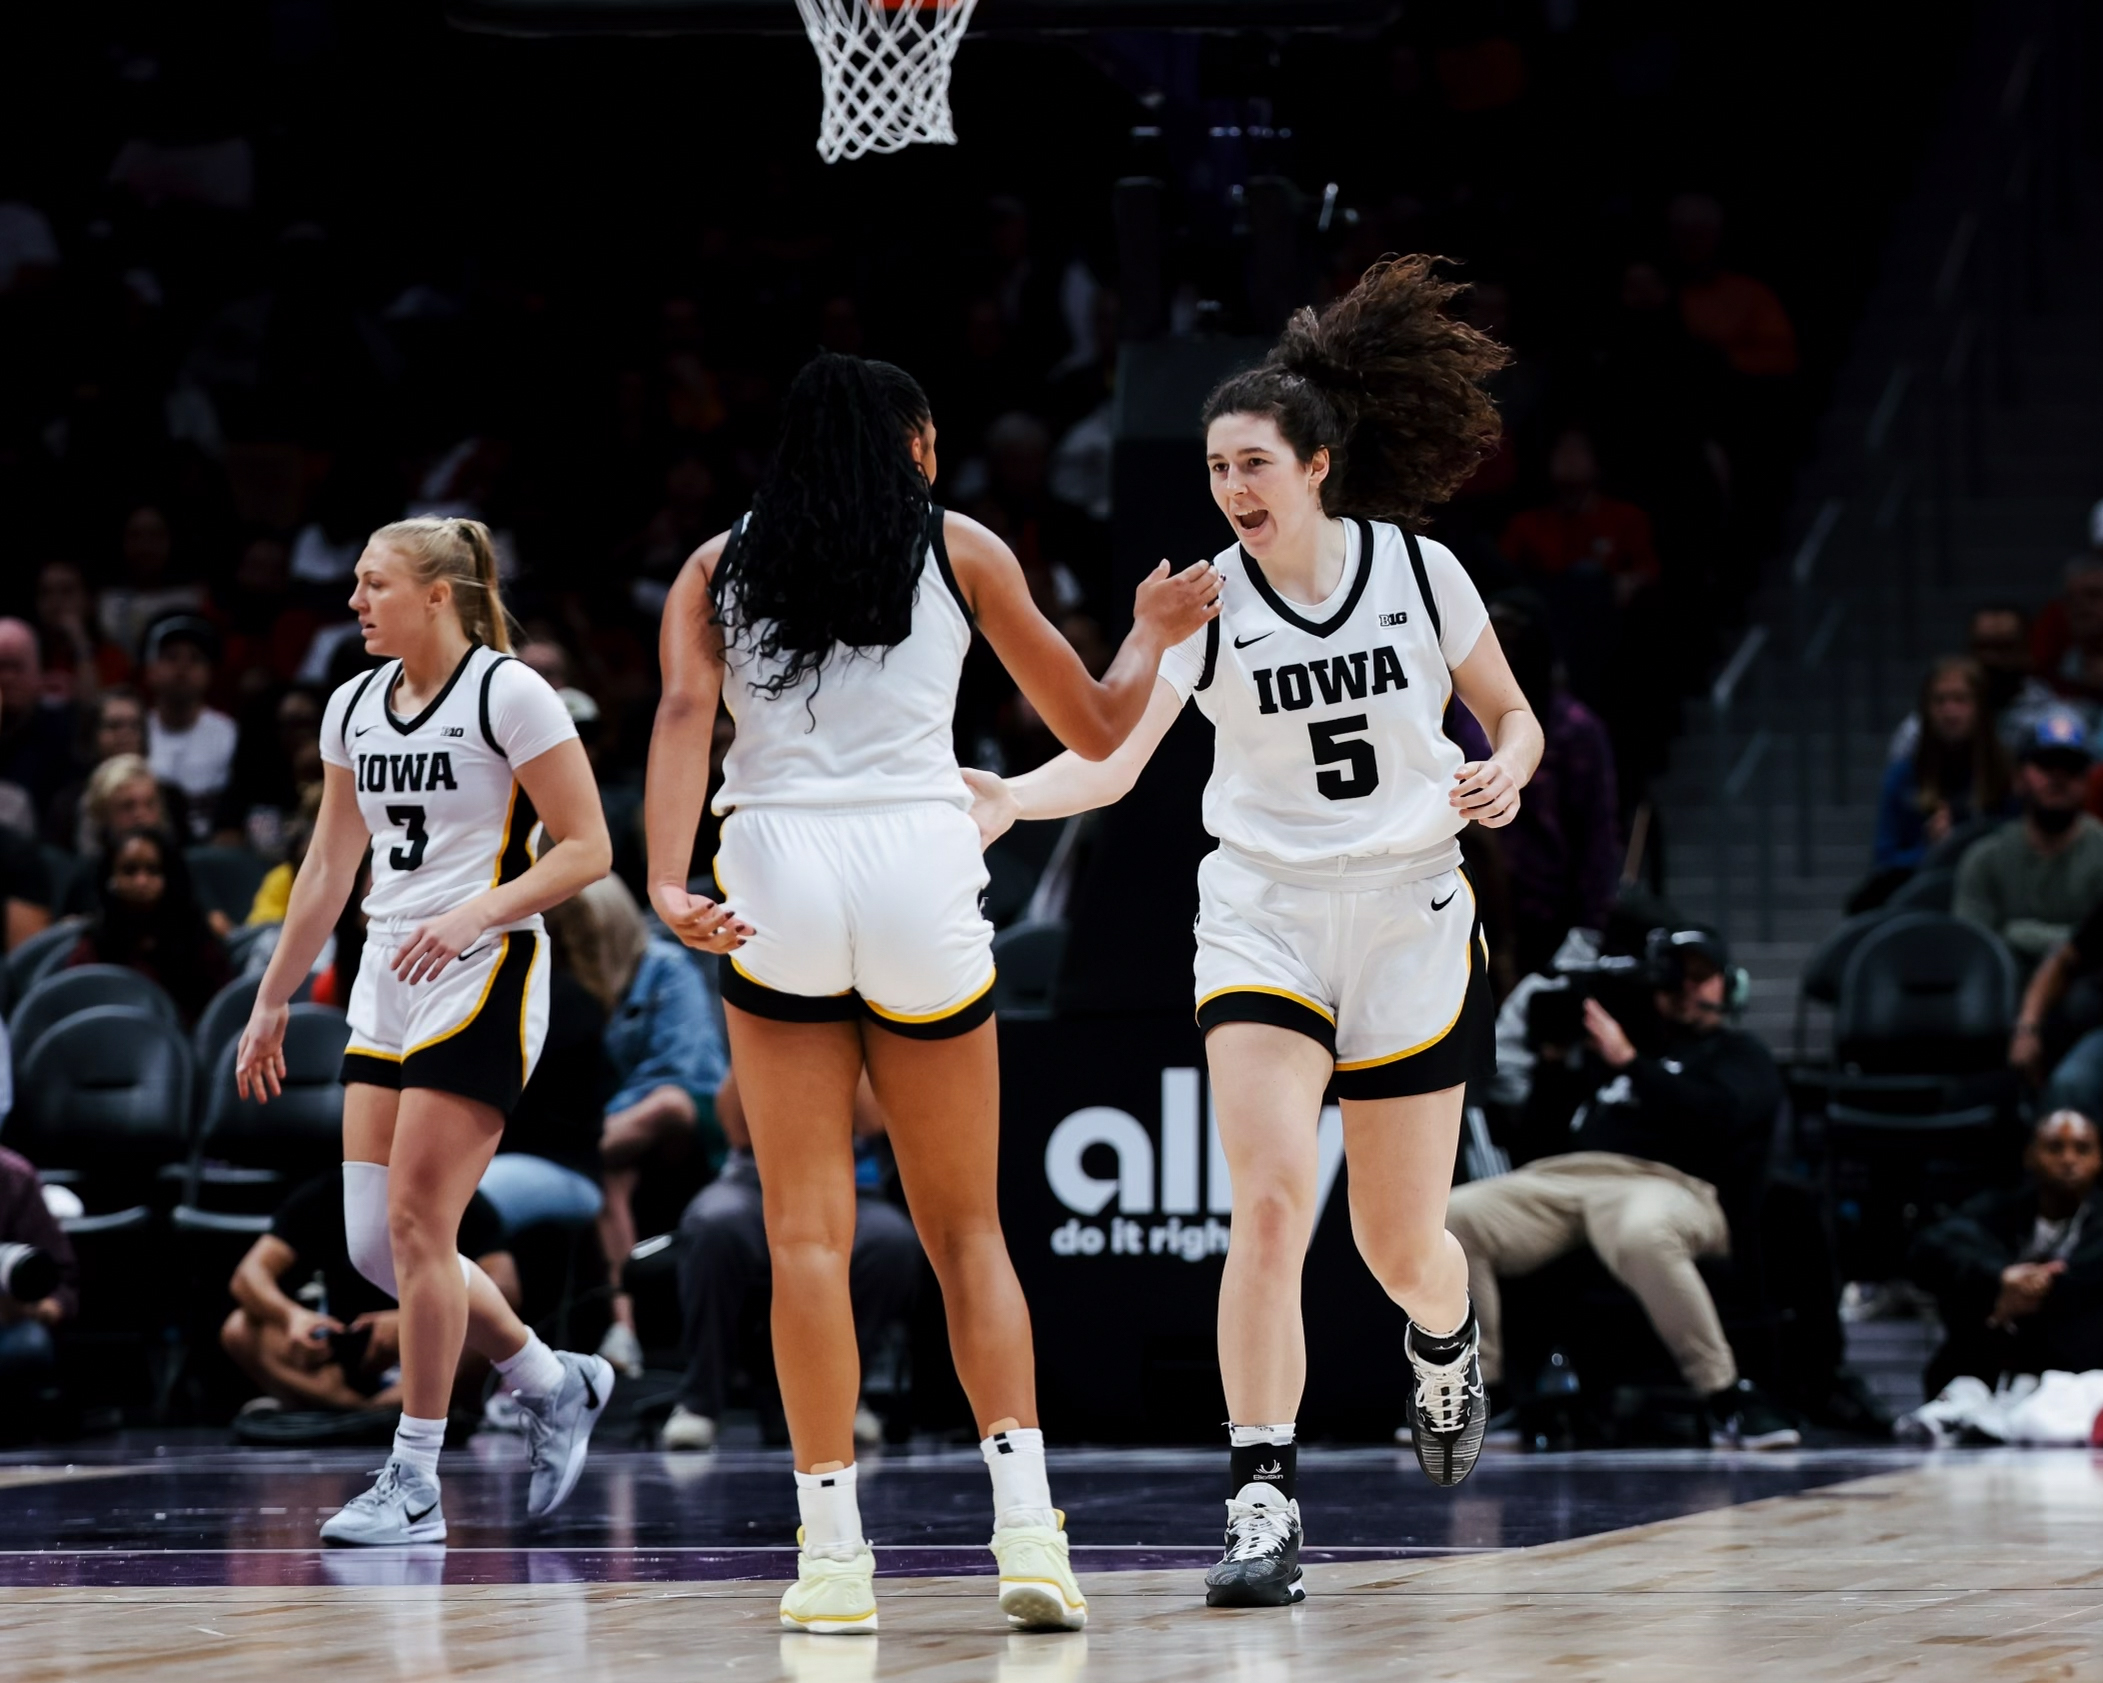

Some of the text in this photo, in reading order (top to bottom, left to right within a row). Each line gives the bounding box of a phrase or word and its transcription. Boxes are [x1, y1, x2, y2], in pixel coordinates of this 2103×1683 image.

[1253, 645, 1408, 715] IOWA
[358, 752, 457, 792] IOWA
[1307, 713, 1379, 801] 5
[386, 805, 429, 871] 3
[1050, 1216, 1231, 1262] do it righ
